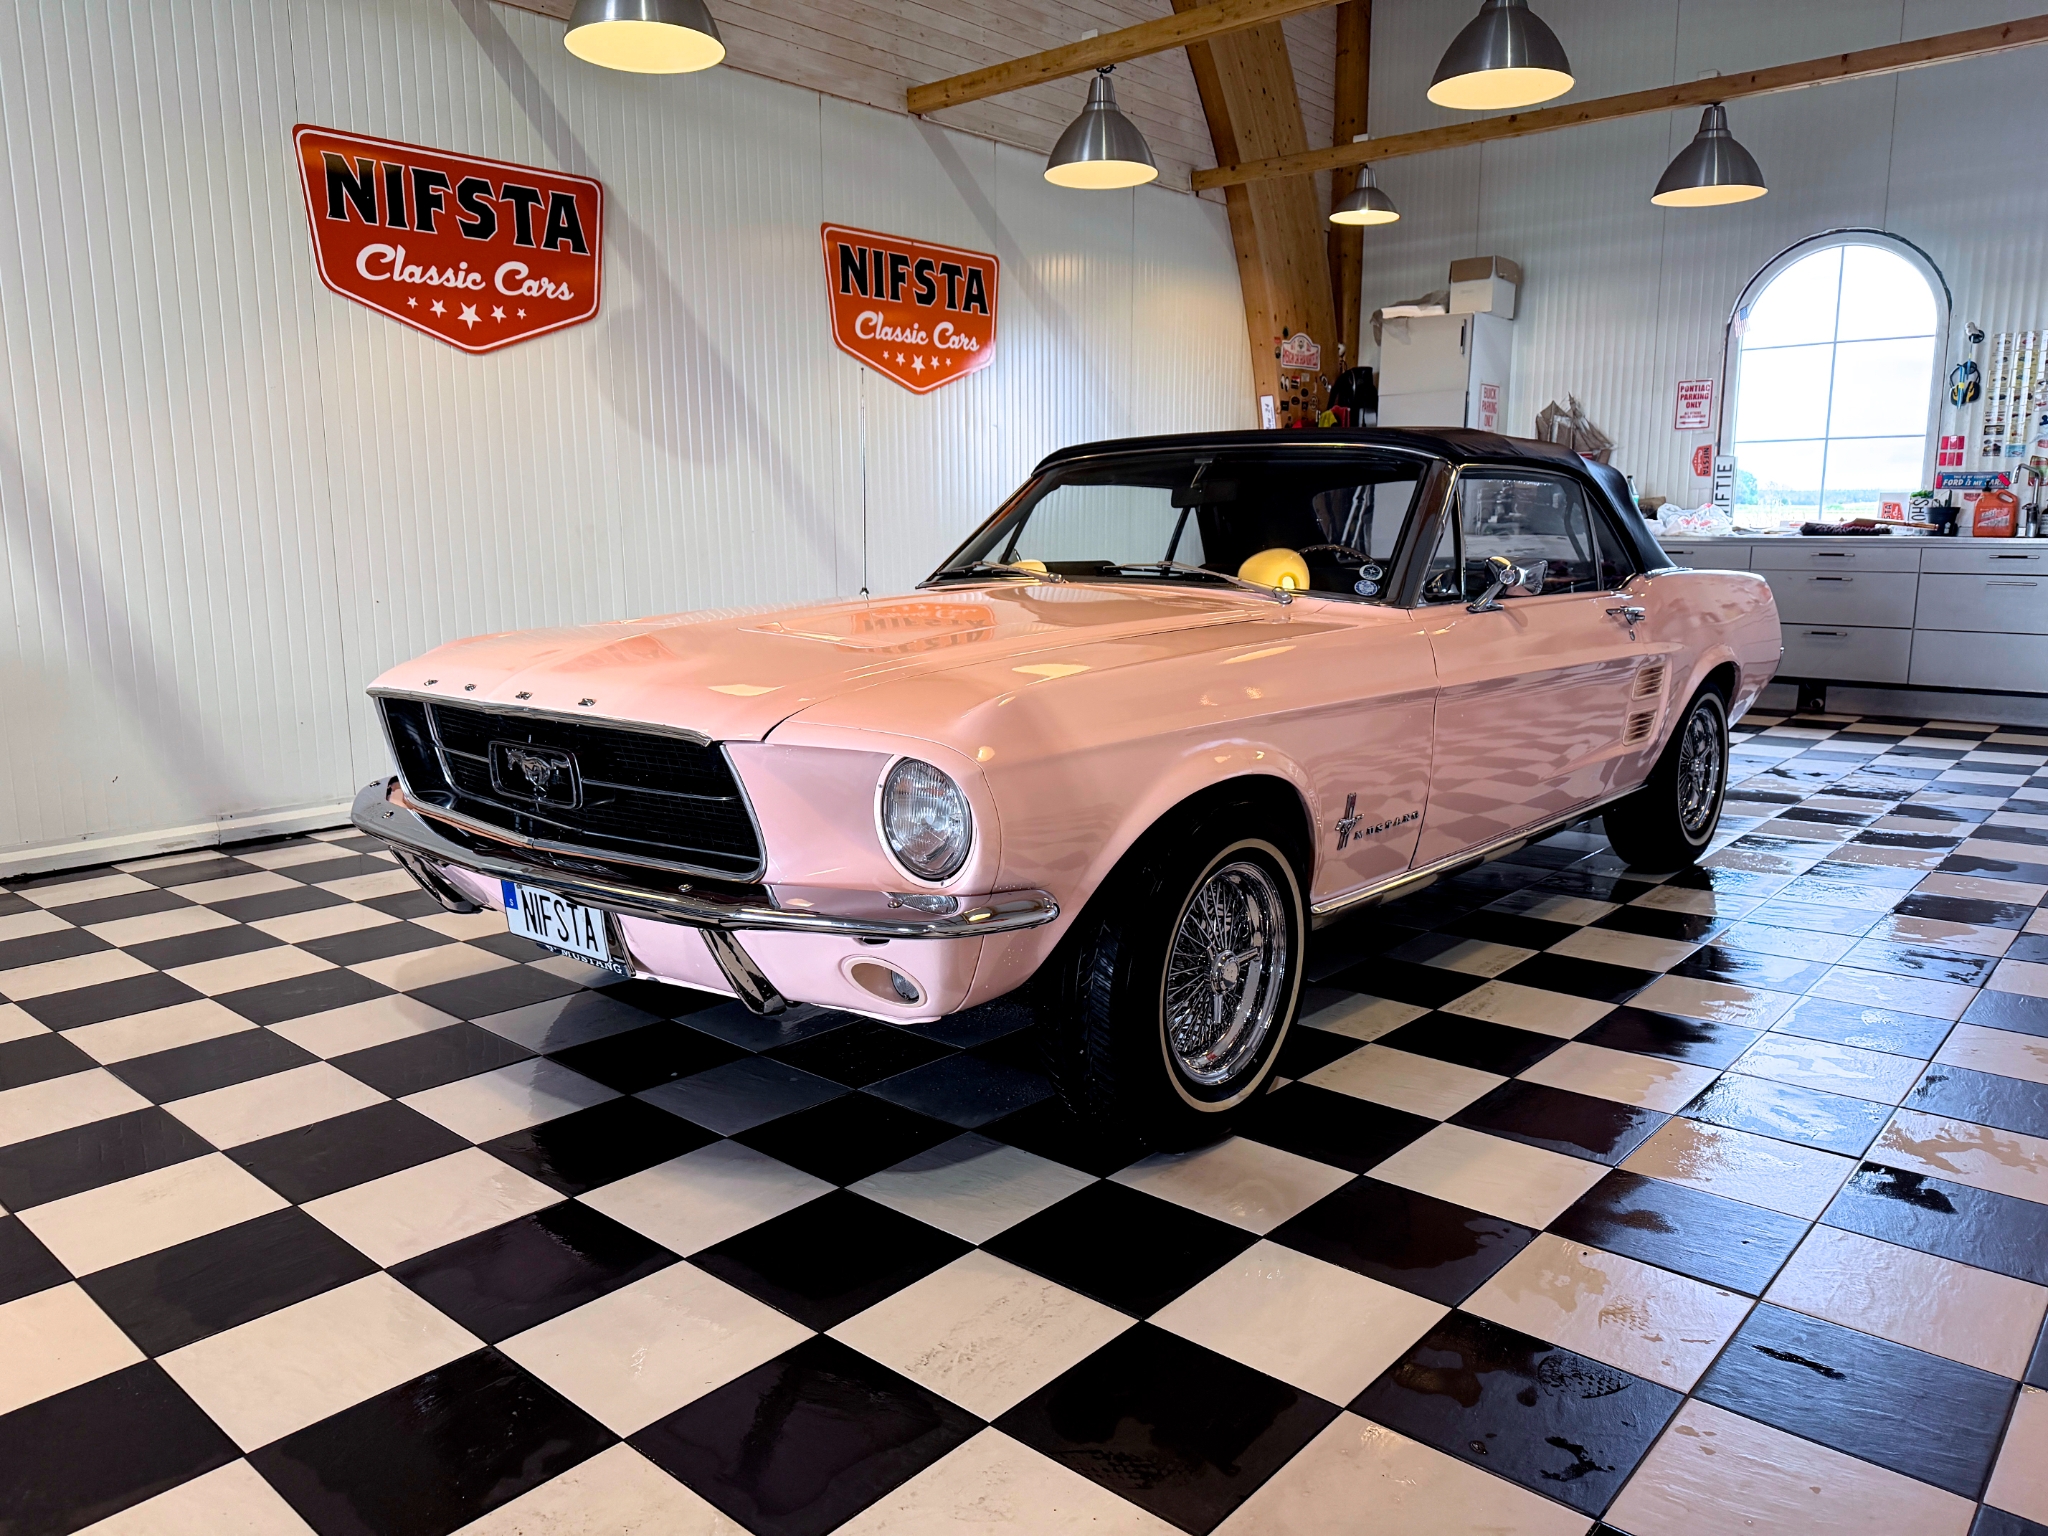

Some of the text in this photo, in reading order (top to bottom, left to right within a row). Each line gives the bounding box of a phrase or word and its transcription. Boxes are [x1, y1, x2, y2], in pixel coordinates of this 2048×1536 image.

[320, 150, 591, 256] NIFSTA
[356, 243, 574, 301] Classic Cars
[837, 242, 990, 316] NIFSTA
[855, 310, 980, 352] Classic Cars
[1484, 387, 1496, 399] BUICK
[1680, 384, 1710, 393] PONTIAC
[1680, 393, 1709, 401] PARKING
[1482, 400, 1497, 414] PARKING
[1484, 414, 1493, 427] ONLY
[1714, 464, 1733, 514] IFTIE
[1354, 811, 1419, 840] MUSTANG
[509, 898, 514, 907] S
[521, 890, 599, 952] NIFSTA
